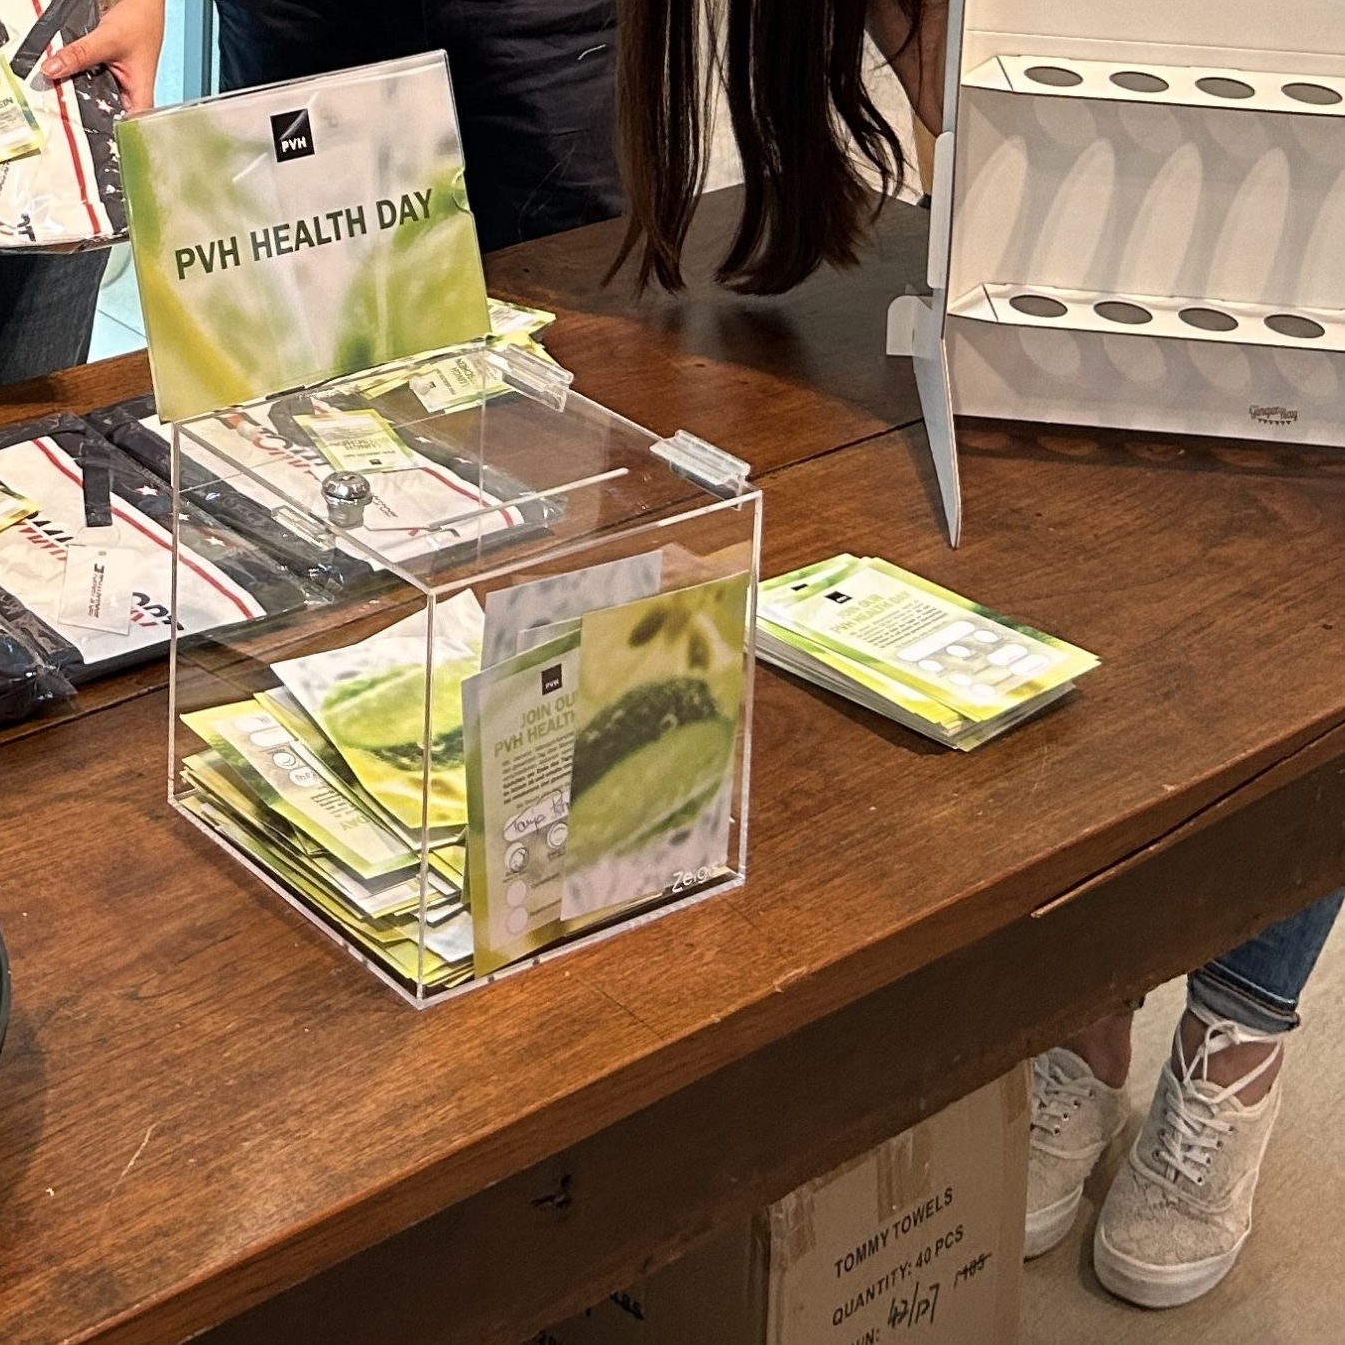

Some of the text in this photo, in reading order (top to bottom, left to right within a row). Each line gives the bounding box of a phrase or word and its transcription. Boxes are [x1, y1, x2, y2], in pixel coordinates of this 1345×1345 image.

[281, 136, 307, 153] PVH
[175, 188, 433, 280] PVH HEALTH DAY
[520, 691, 576, 728] JOIN OU
[495, 731, 524, 757] PVH
[834, 1187, 953, 1279] TOMMY TOWELS
[832, 1225, 964, 1326] QUANTITY: 40 PCS
